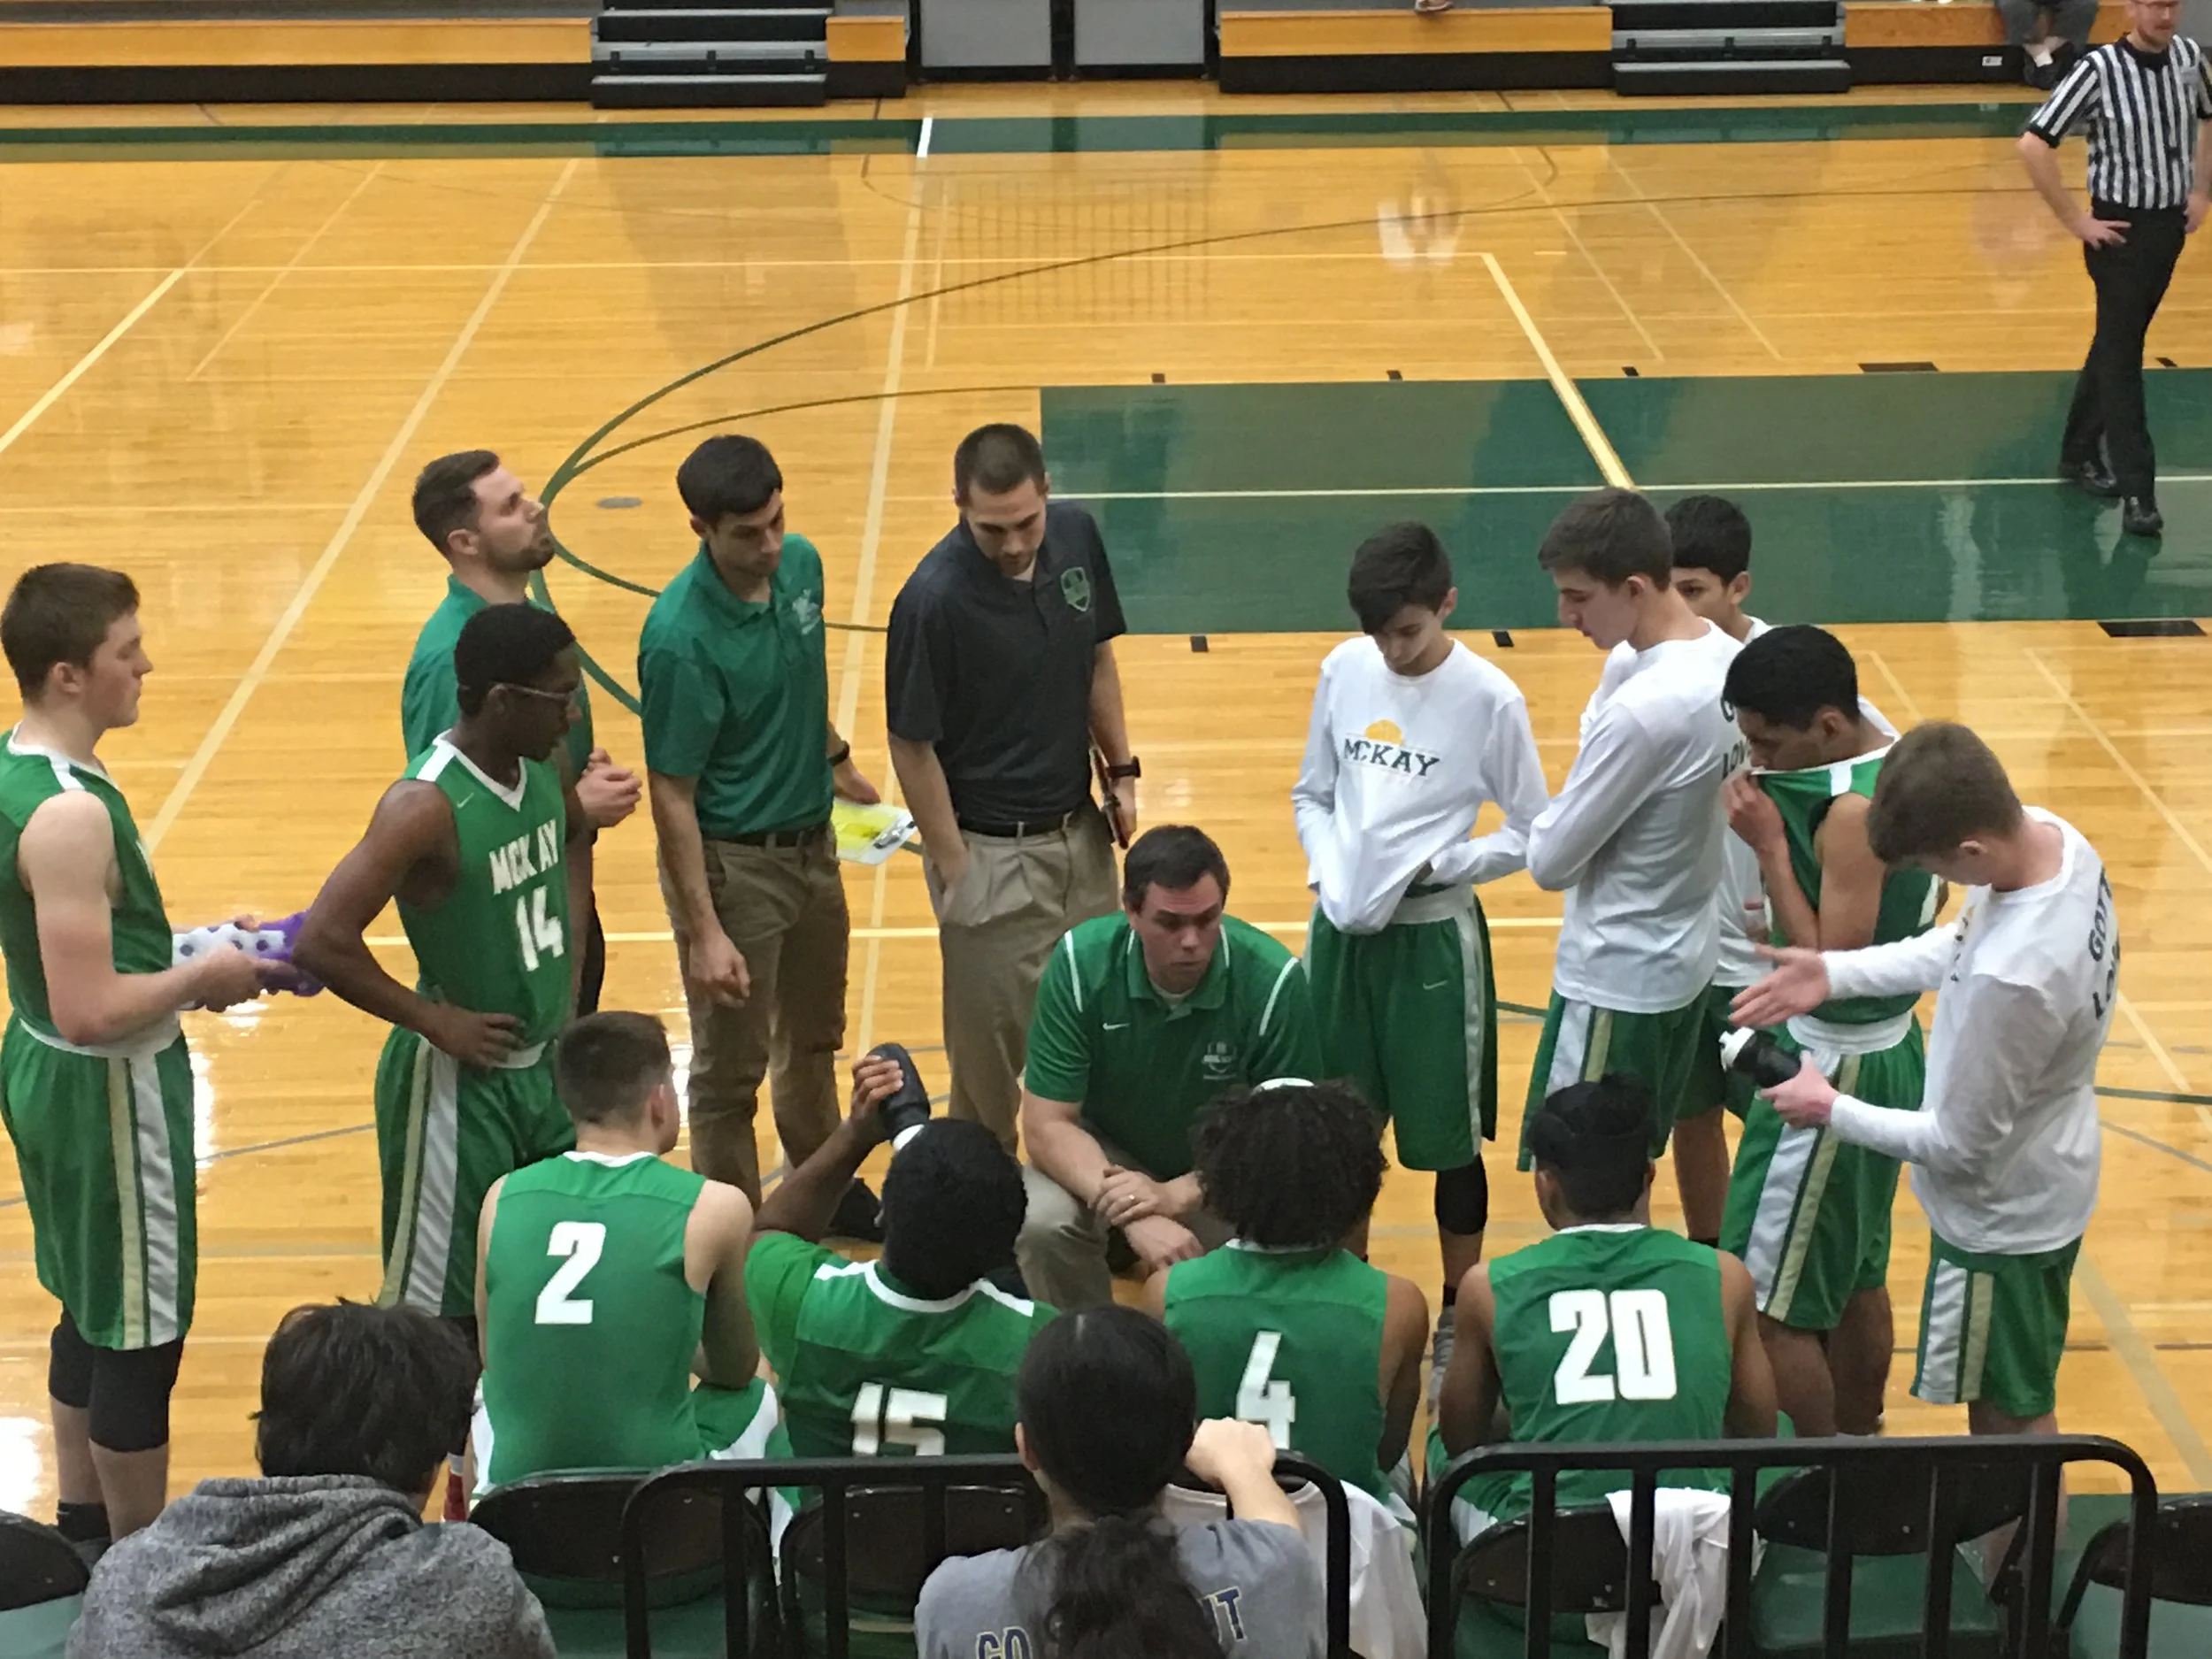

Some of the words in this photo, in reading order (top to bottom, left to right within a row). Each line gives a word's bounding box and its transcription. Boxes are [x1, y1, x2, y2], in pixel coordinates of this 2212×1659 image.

[516, 885, 565, 972] 14
[534, 1220, 607, 1325] 2
[1236, 1330, 1296, 1449] 4
[1548, 1288, 1678, 1405] 20
[849, 1381, 948, 1456] 15
